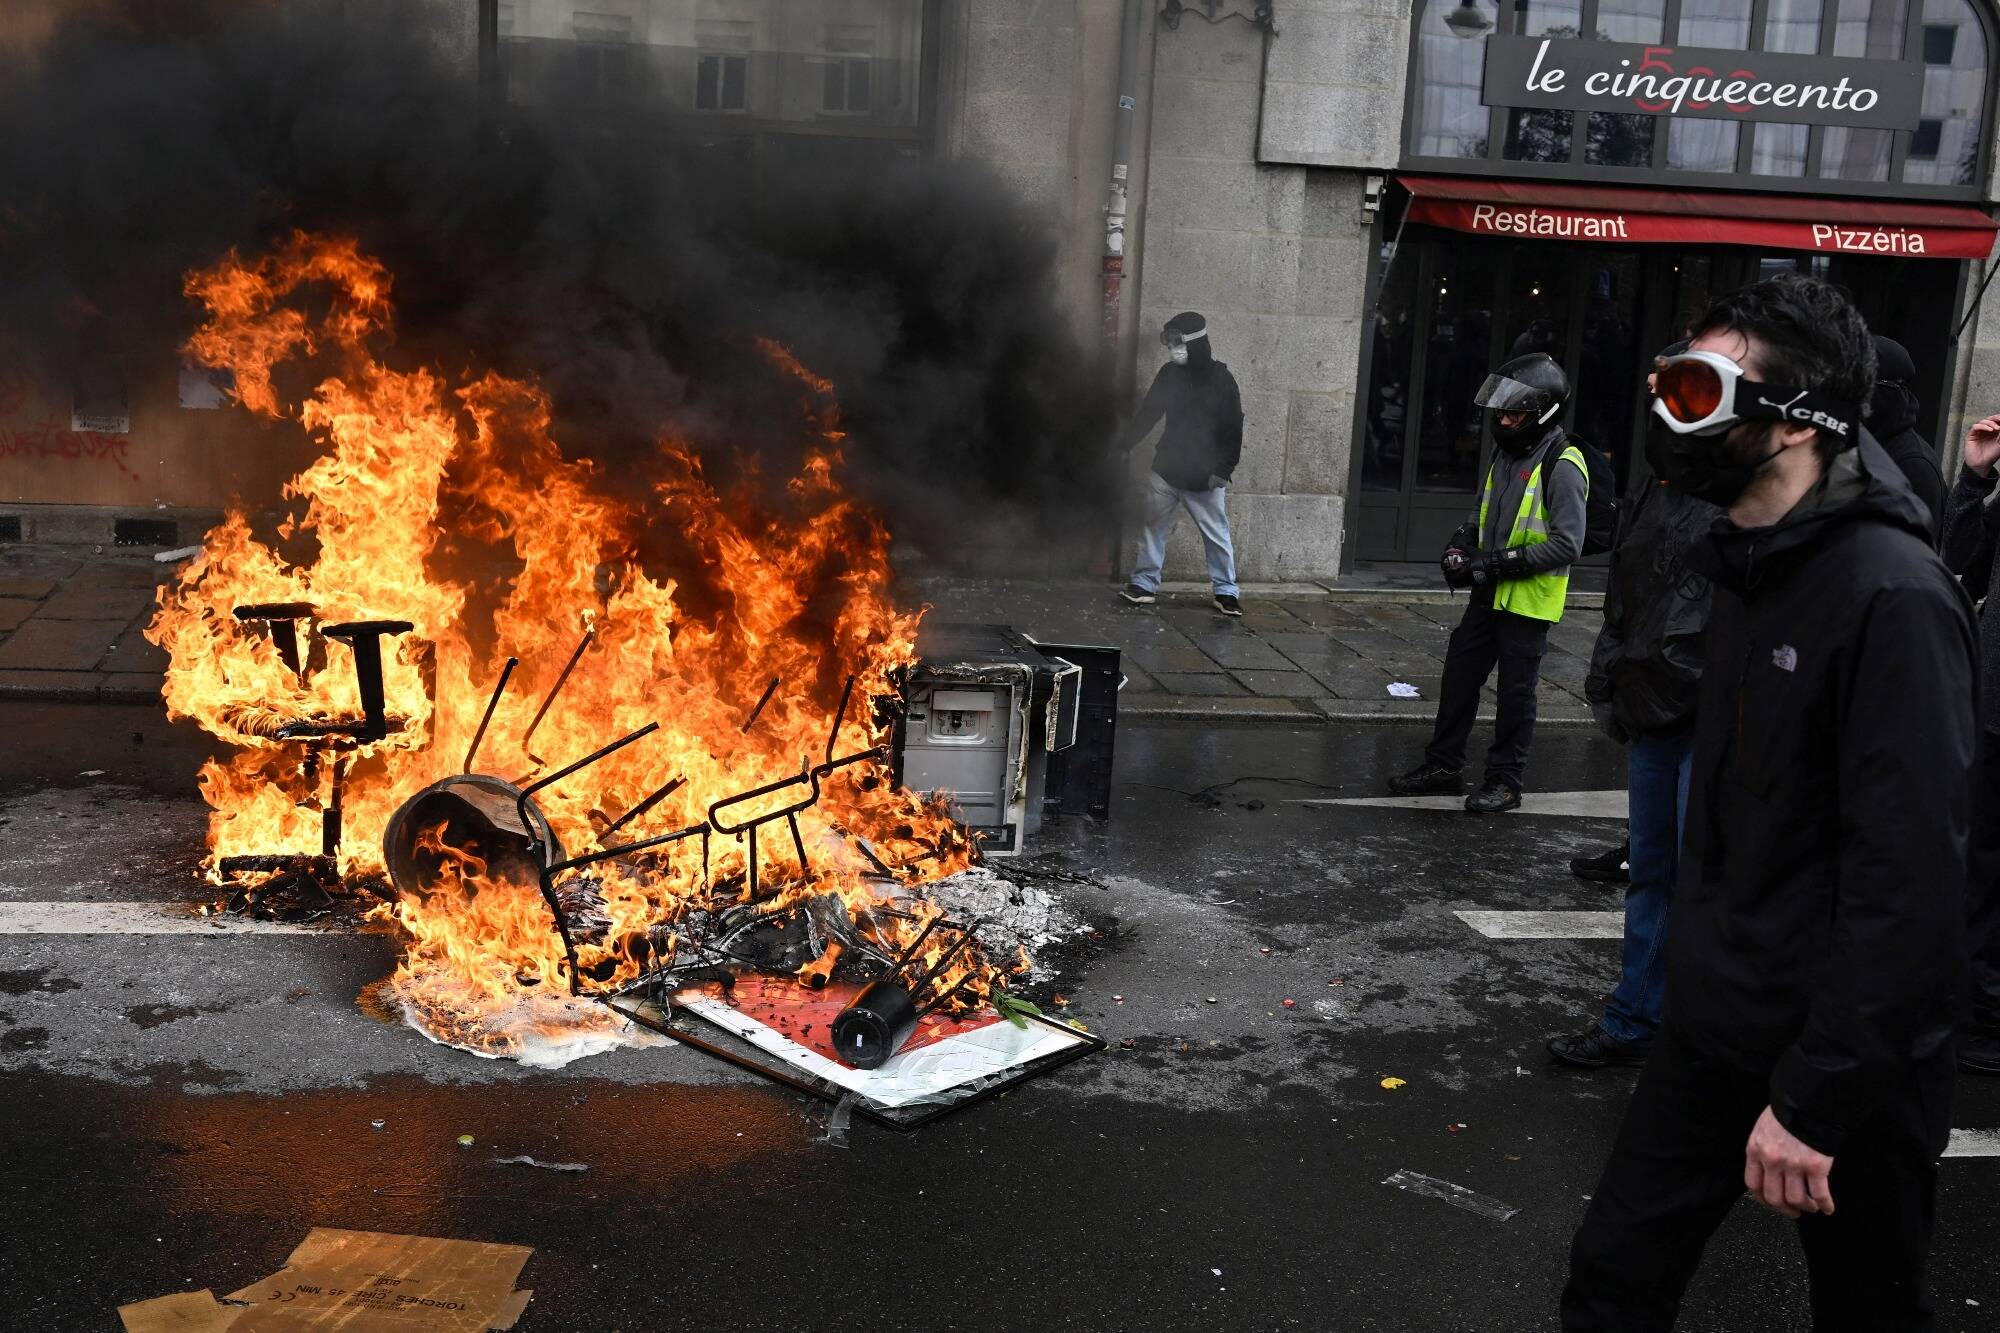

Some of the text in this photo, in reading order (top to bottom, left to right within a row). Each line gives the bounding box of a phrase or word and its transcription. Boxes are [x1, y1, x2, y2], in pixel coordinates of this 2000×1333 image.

[1526, 39, 1878, 114] le cinquecento
[1472, 204, 1628, 238] Restaurant
[1812, 224, 1925, 253] Pizzéria
[295, 1284, 322, 1295] MIN
[329, 1288, 347, 1297] 45
[352, 1290, 387, 1300] CIRE
[396, 1294, 466, 1311] TORCHES
